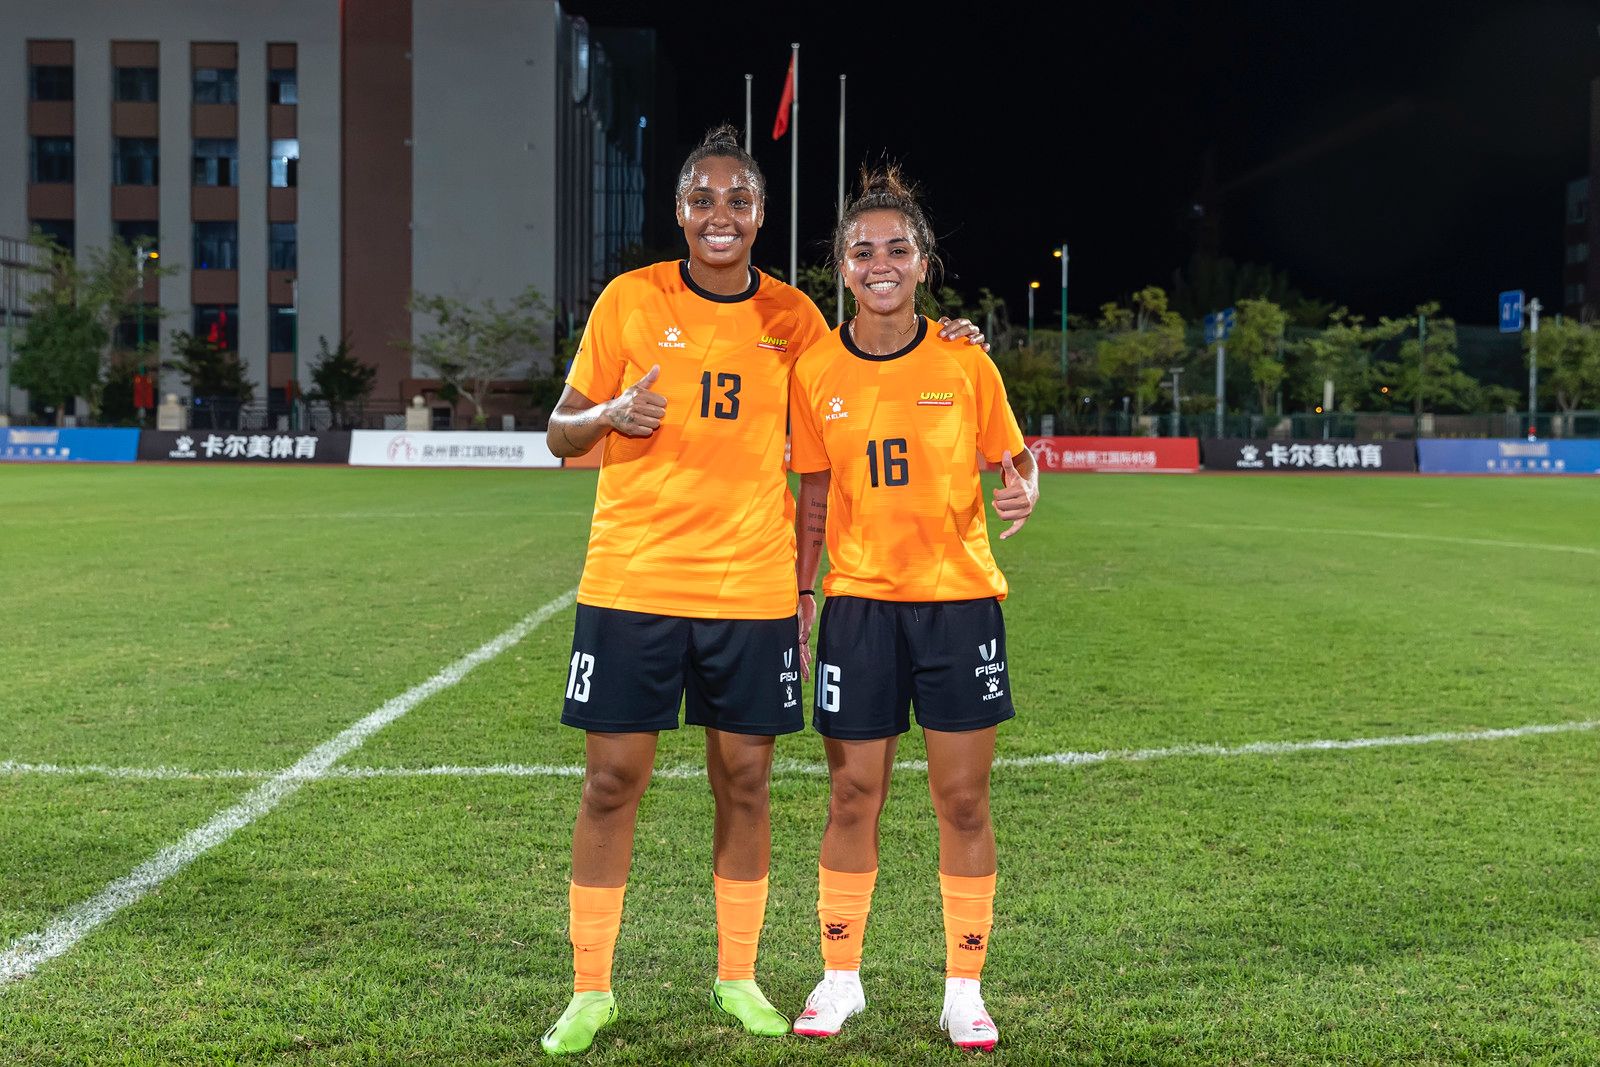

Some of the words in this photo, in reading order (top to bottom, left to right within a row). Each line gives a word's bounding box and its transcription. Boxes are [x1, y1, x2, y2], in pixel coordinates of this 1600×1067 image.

[761, 335, 788, 346] UNIP
[700, 371, 741, 420] 13
[920, 392, 954, 400] UNIP
[825, 412, 849, 421] KELME
[200, 434, 319, 459] 卡尔美体育
[1265, 443, 1383, 468] 卡尔美体育
[866, 438, 909, 487] 16
[566, 651, 595, 703] 13
[975, 661, 1004, 677] FISU
[817, 661, 841, 713] 16
[983, 690, 1004, 701] KELME
[959, 943, 985, 951] KELME
